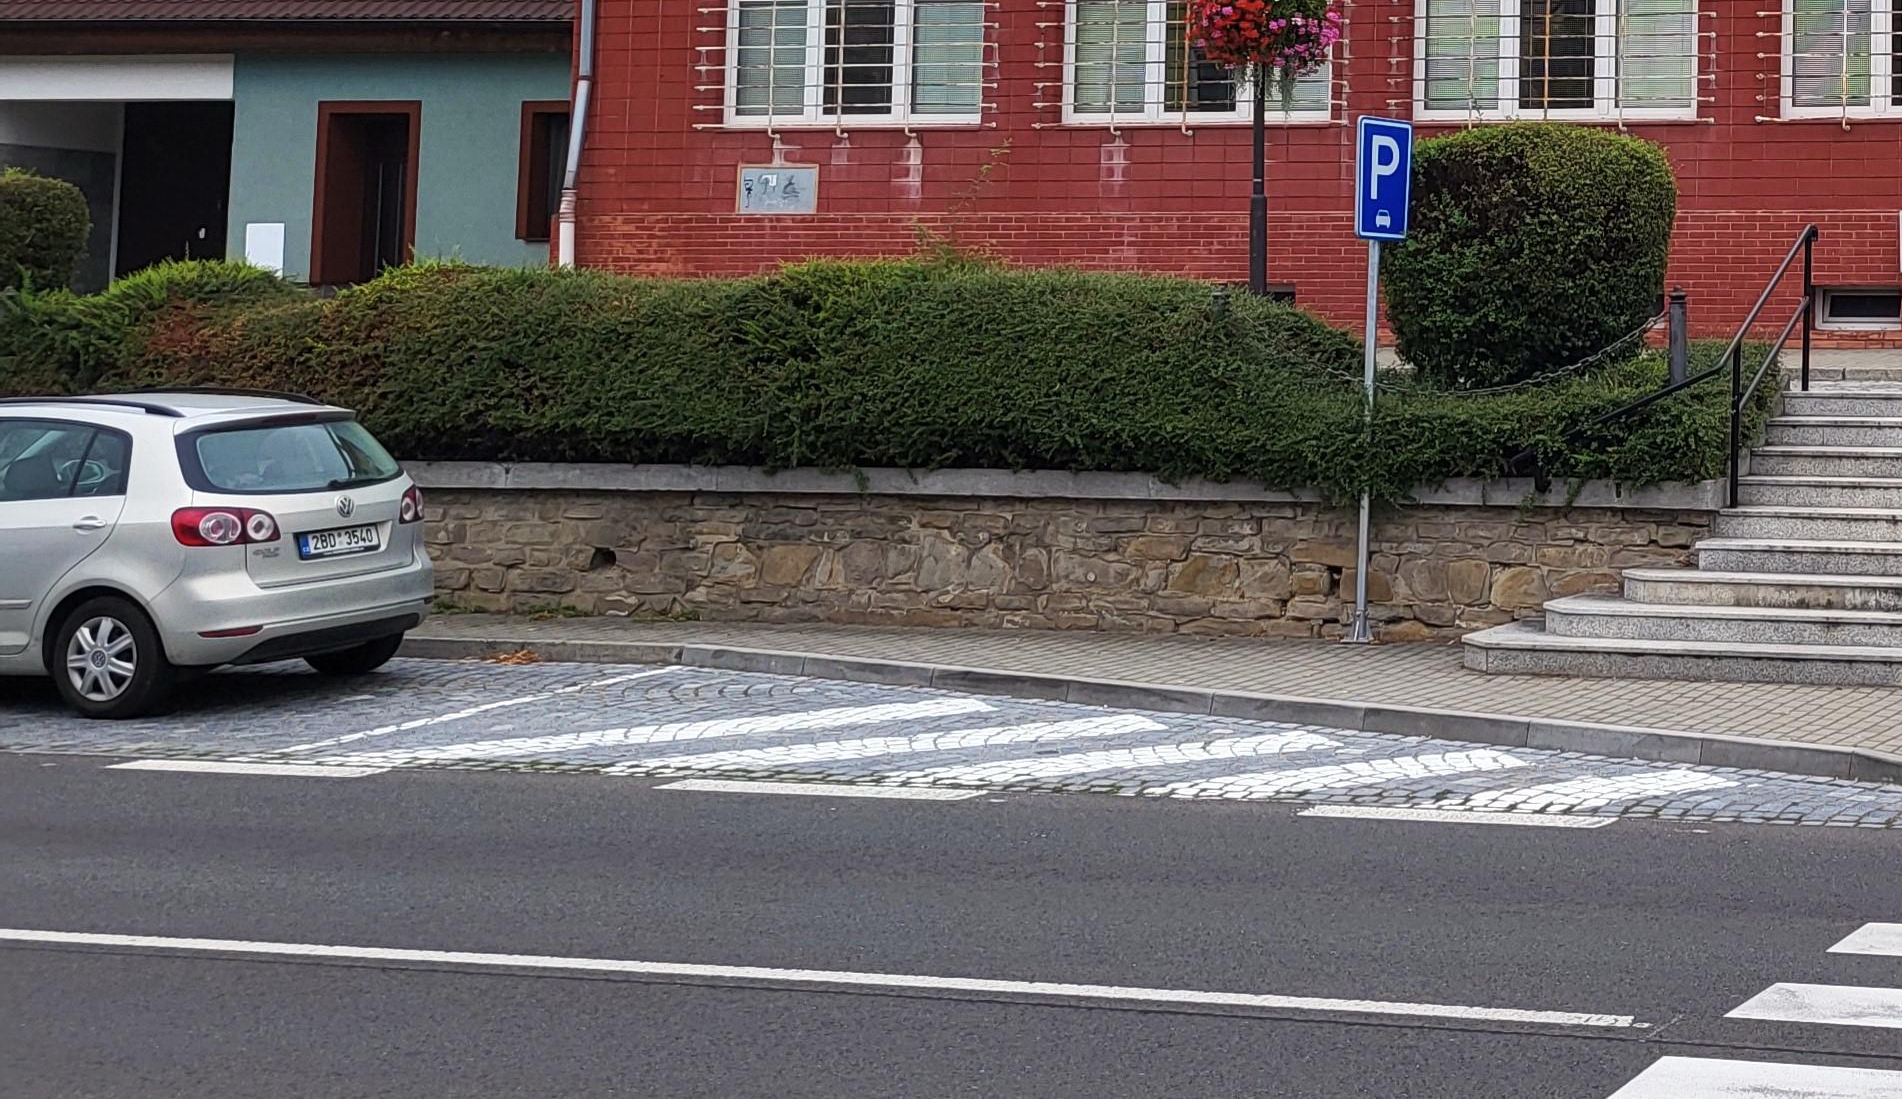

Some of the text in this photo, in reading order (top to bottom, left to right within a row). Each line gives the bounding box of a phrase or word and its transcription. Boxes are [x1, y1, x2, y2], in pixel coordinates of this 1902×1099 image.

[1370, 135, 1400, 200] P
[312, 528, 373, 550] 2BD 3540
